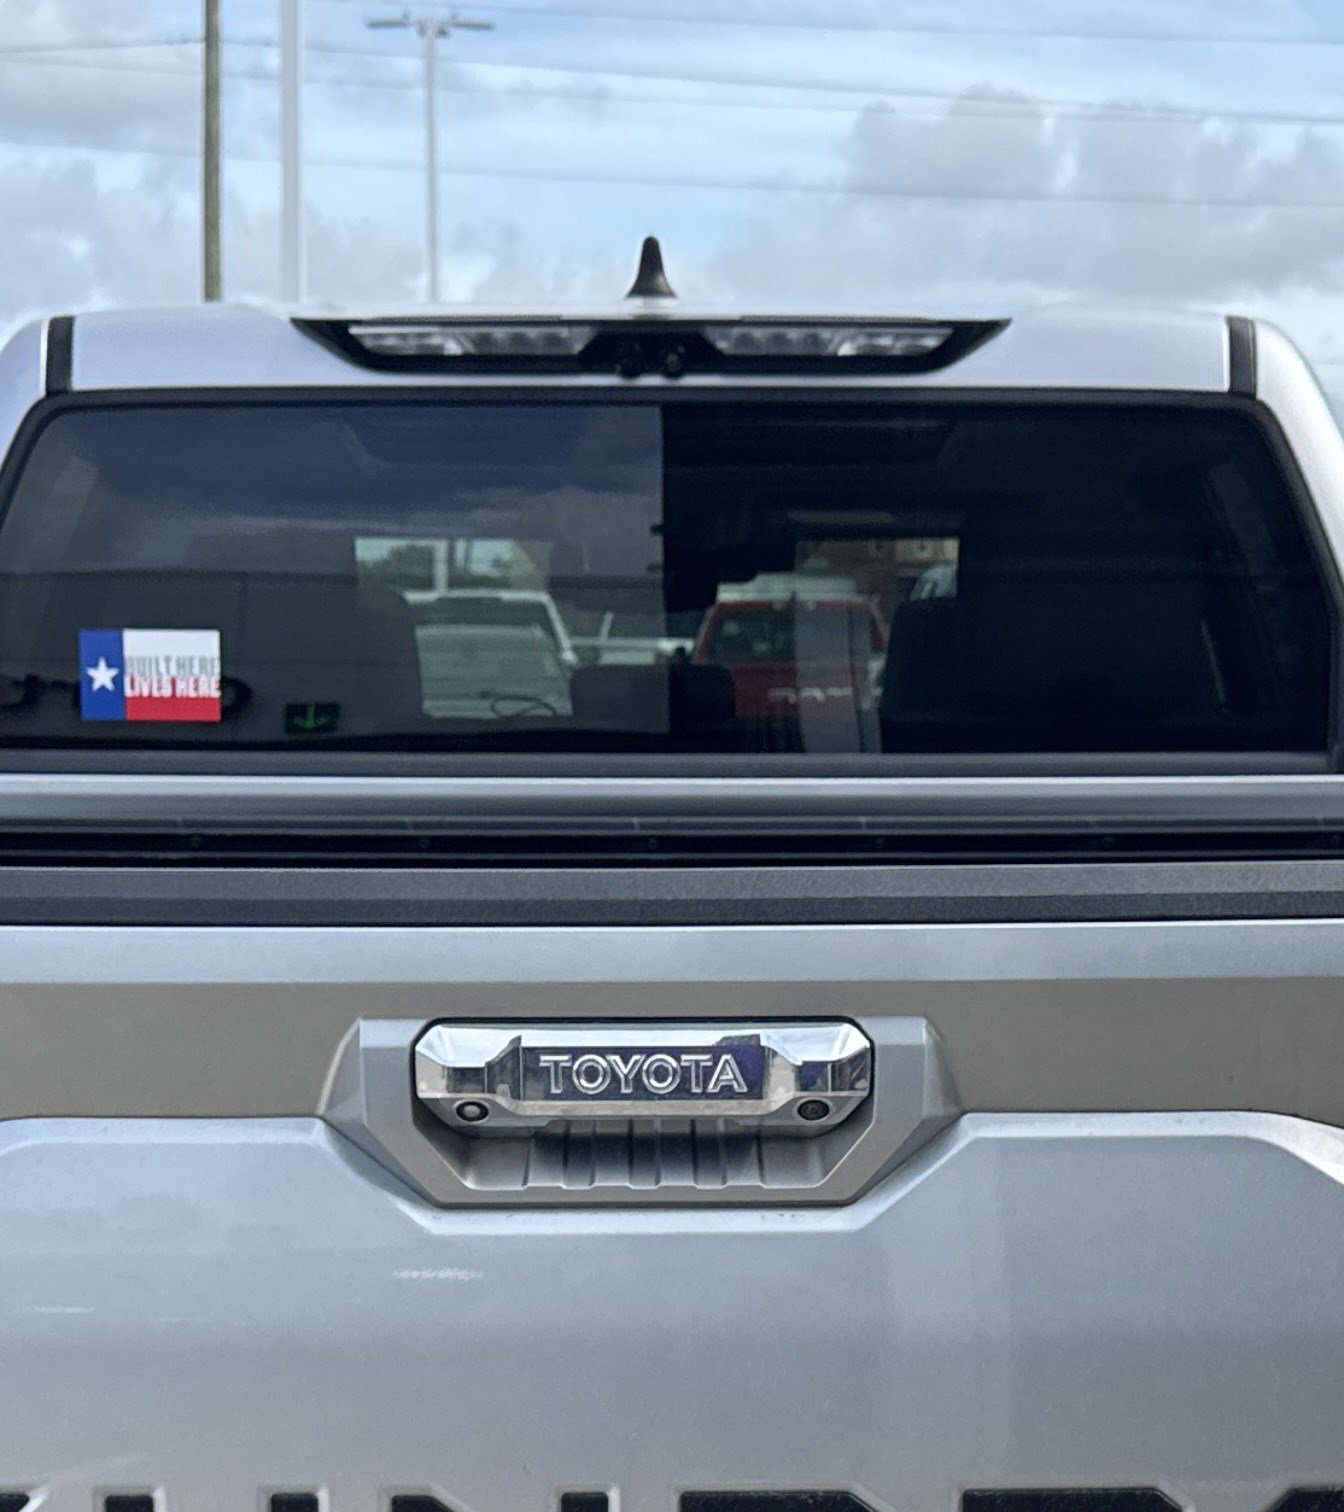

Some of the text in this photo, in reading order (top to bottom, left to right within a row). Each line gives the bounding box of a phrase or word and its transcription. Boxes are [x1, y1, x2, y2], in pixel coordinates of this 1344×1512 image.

[125, 656, 219, 675] BUILT HERE
[125, 675, 221, 698] LIVES HERE
[539, 1053, 749, 1095] TOYOTA
